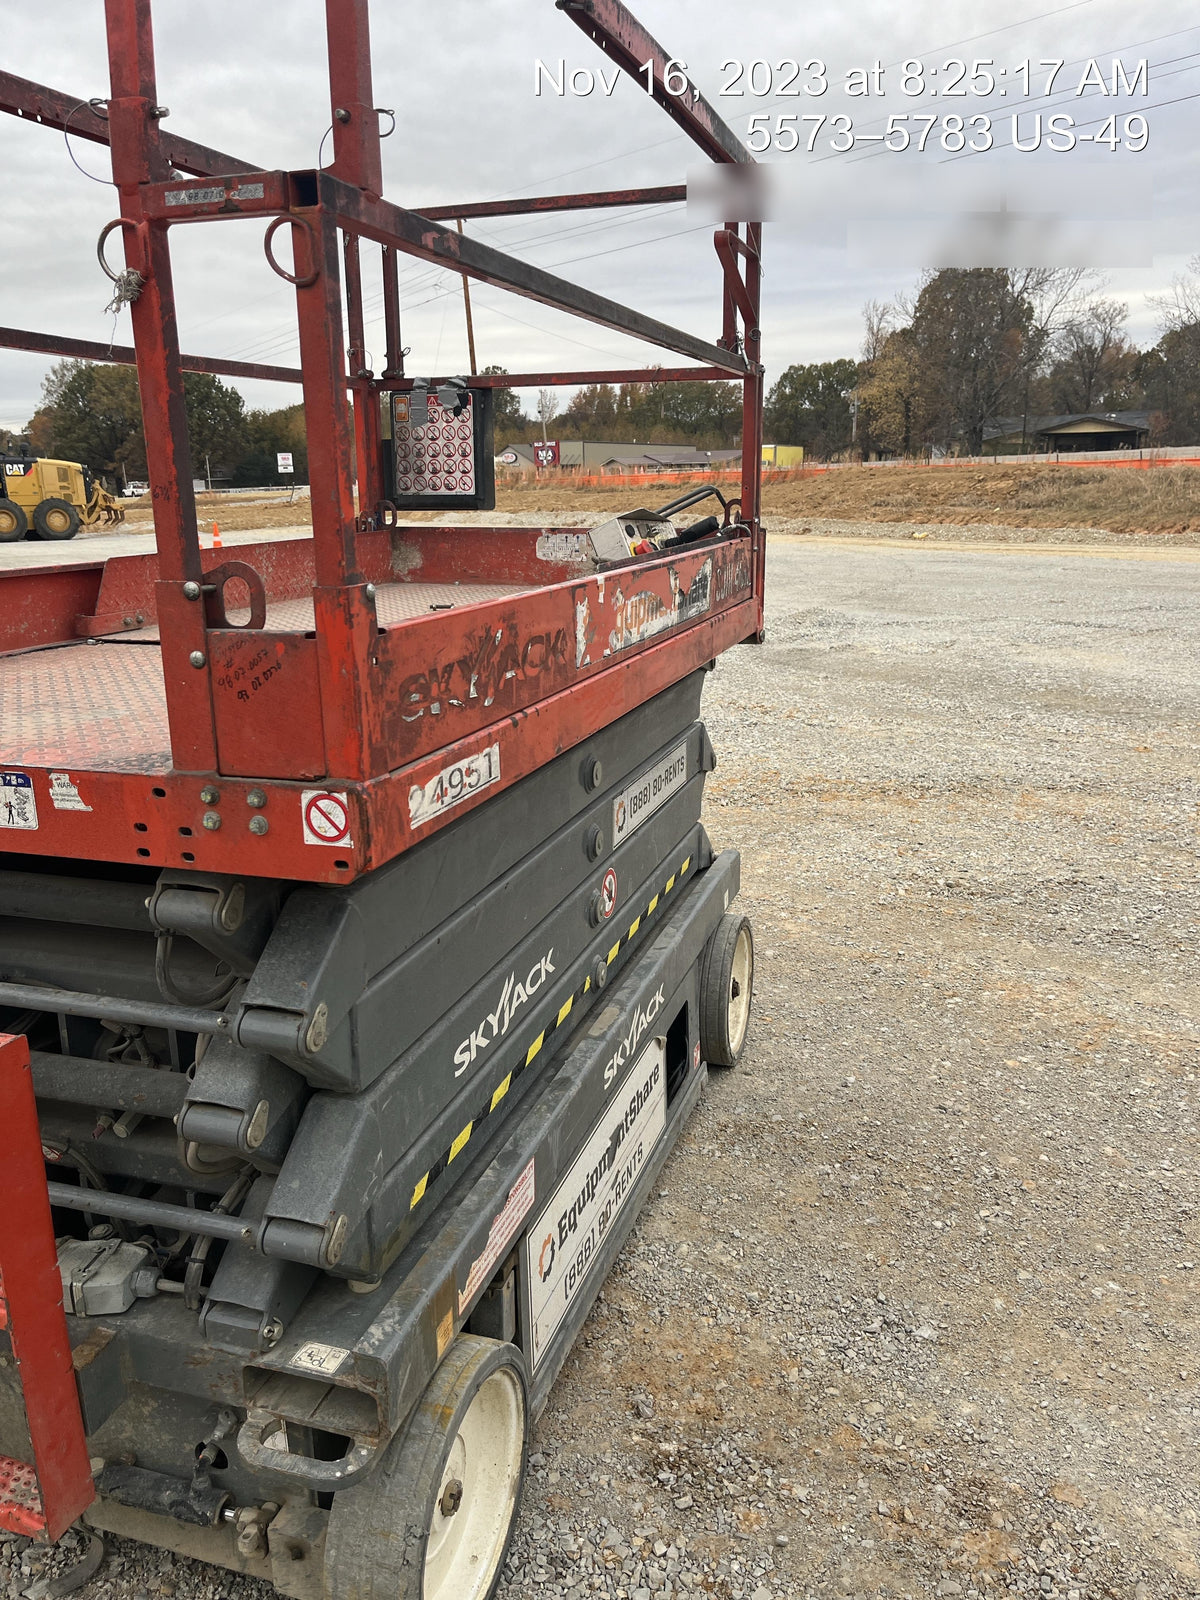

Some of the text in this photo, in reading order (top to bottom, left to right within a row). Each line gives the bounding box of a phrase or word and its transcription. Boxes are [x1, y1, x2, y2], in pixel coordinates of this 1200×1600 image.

[6, 464, 24, 475] CAT
[409, 750, 493, 820] 24951
[629, 755, 685, 819] (888) 80-RENTS
[454, 947, 556, 1078] SKYJACK
[603, 982, 665, 1090] SKYJACK
[558, 1063, 660, 1250] EquipmntShare
[564, 1229, 597, 1300] (888)
